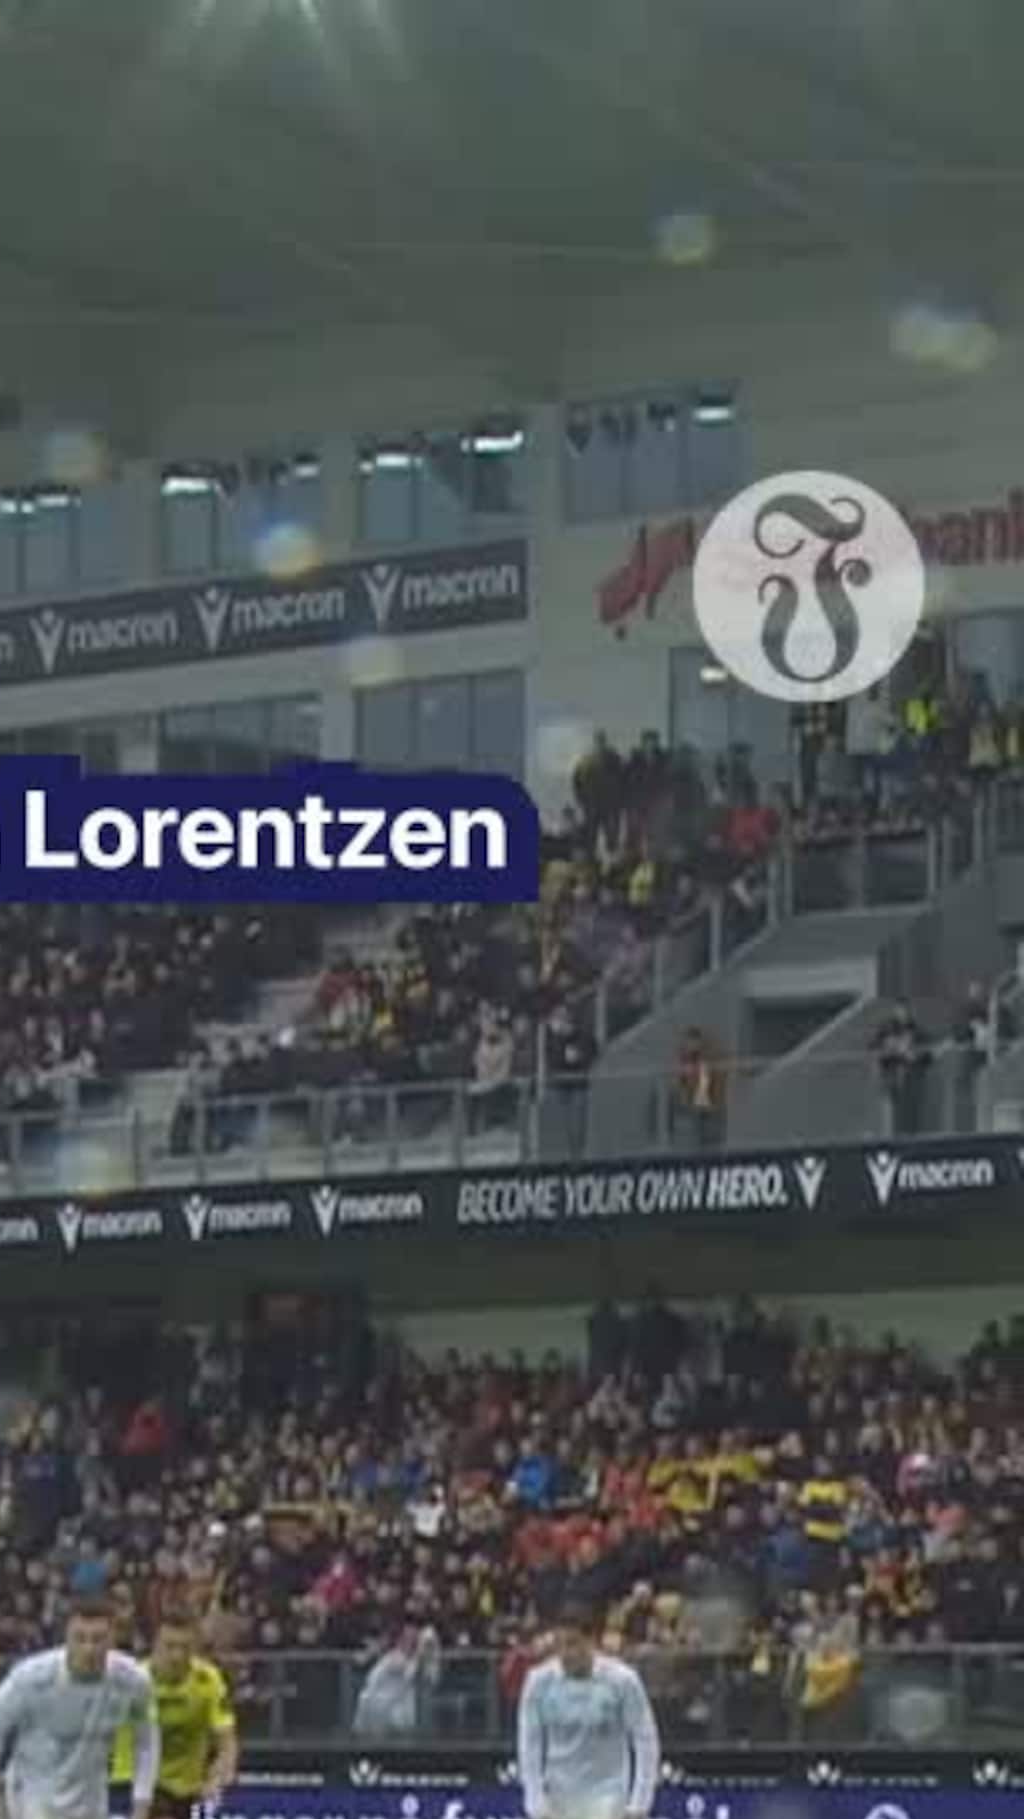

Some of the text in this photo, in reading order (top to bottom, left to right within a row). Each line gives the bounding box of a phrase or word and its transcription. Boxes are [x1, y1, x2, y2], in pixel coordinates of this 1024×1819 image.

[67, 610, 176, 655] macron
[230, 587, 345, 634] macron
[402, 563, 520, 608] macron
[209, 1201, 291, 1232] macron
[338, 1192, 423, 1223] macron
[456, 1173, 561, 1224] BECOME
[563, 1173, 634, 1216] YOUR
[635, 1167, 705, 1215] OWN
[705, 1162, 788, 1209] HERO.
[897, 1157, 995, 1192] macron
